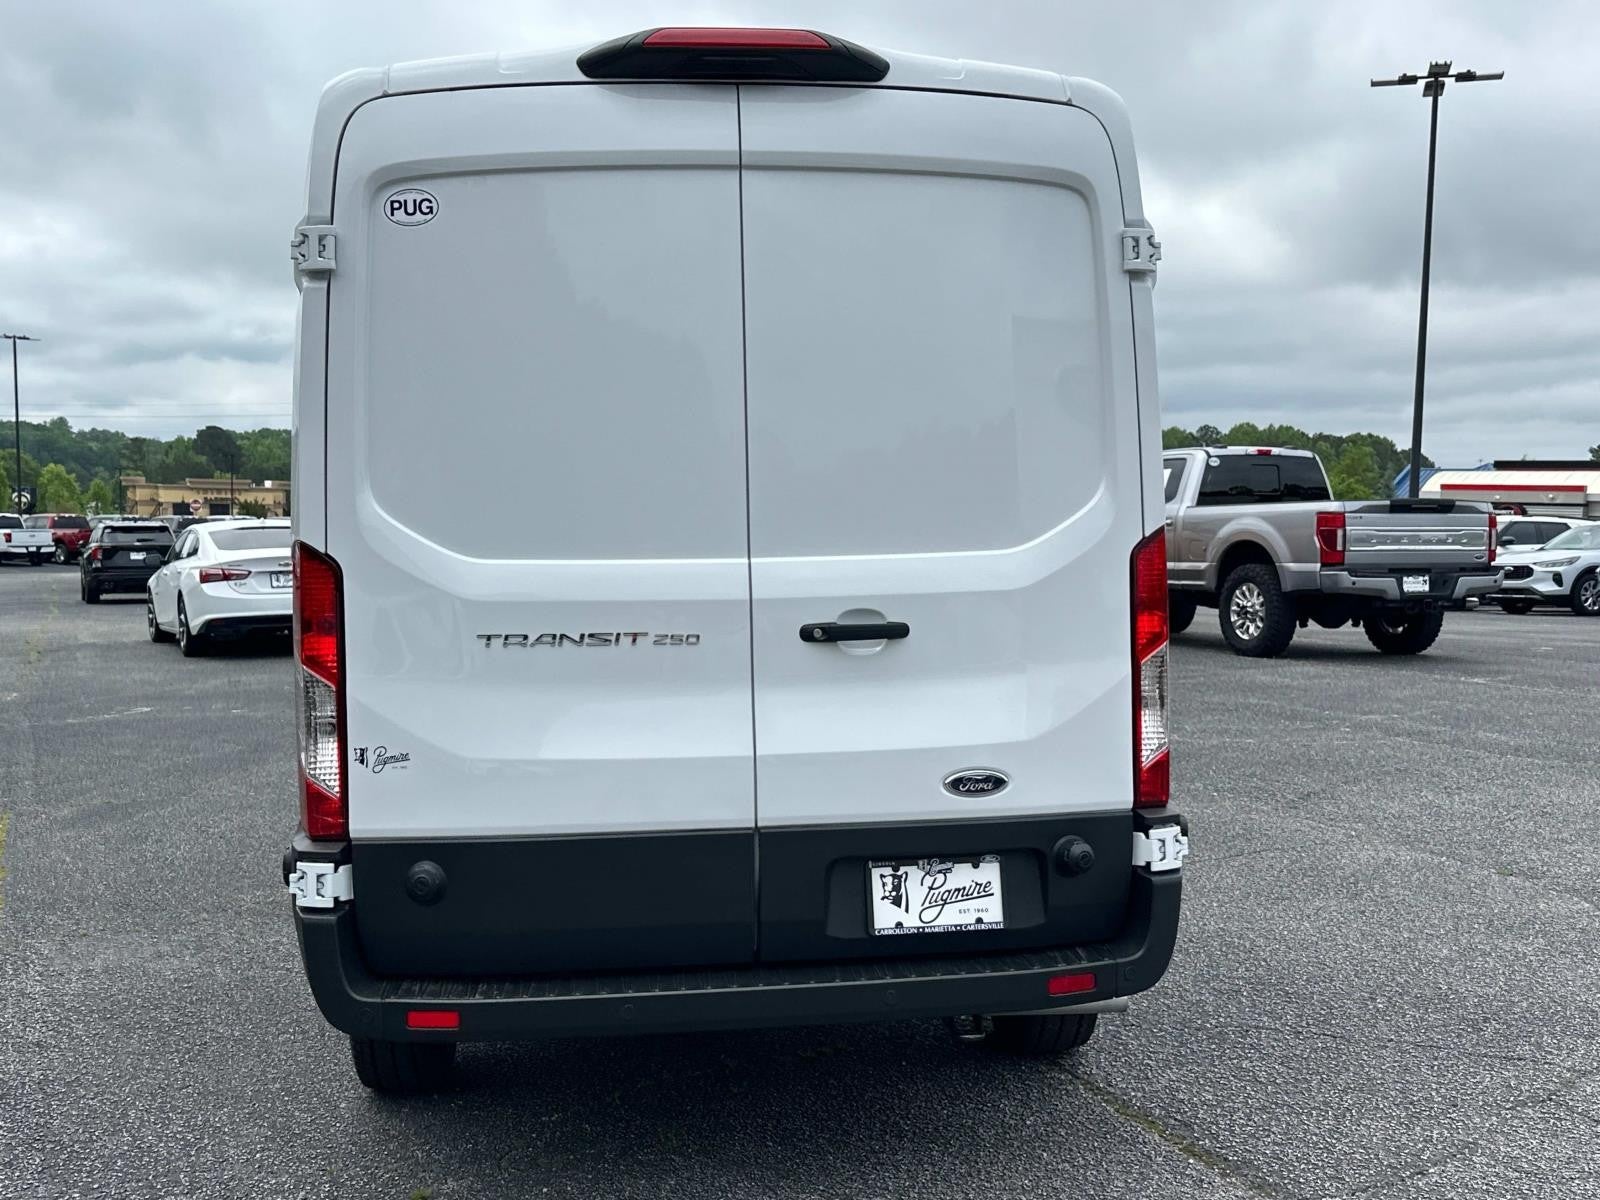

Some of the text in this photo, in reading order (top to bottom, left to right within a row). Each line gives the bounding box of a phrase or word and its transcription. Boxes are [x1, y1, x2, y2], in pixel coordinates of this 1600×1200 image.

[390, 198, 434, 217] PUG
[476, 632, 700, 648] TRANSIT 250
[372, 745, 411, 774] Pugmire
[959, 775, 994, 791] Ford
[919, 871, 995, 924] Pugmire
[875, 922, 1004, 936] CARROLLTON MARIETTA CARTERSVILLE
